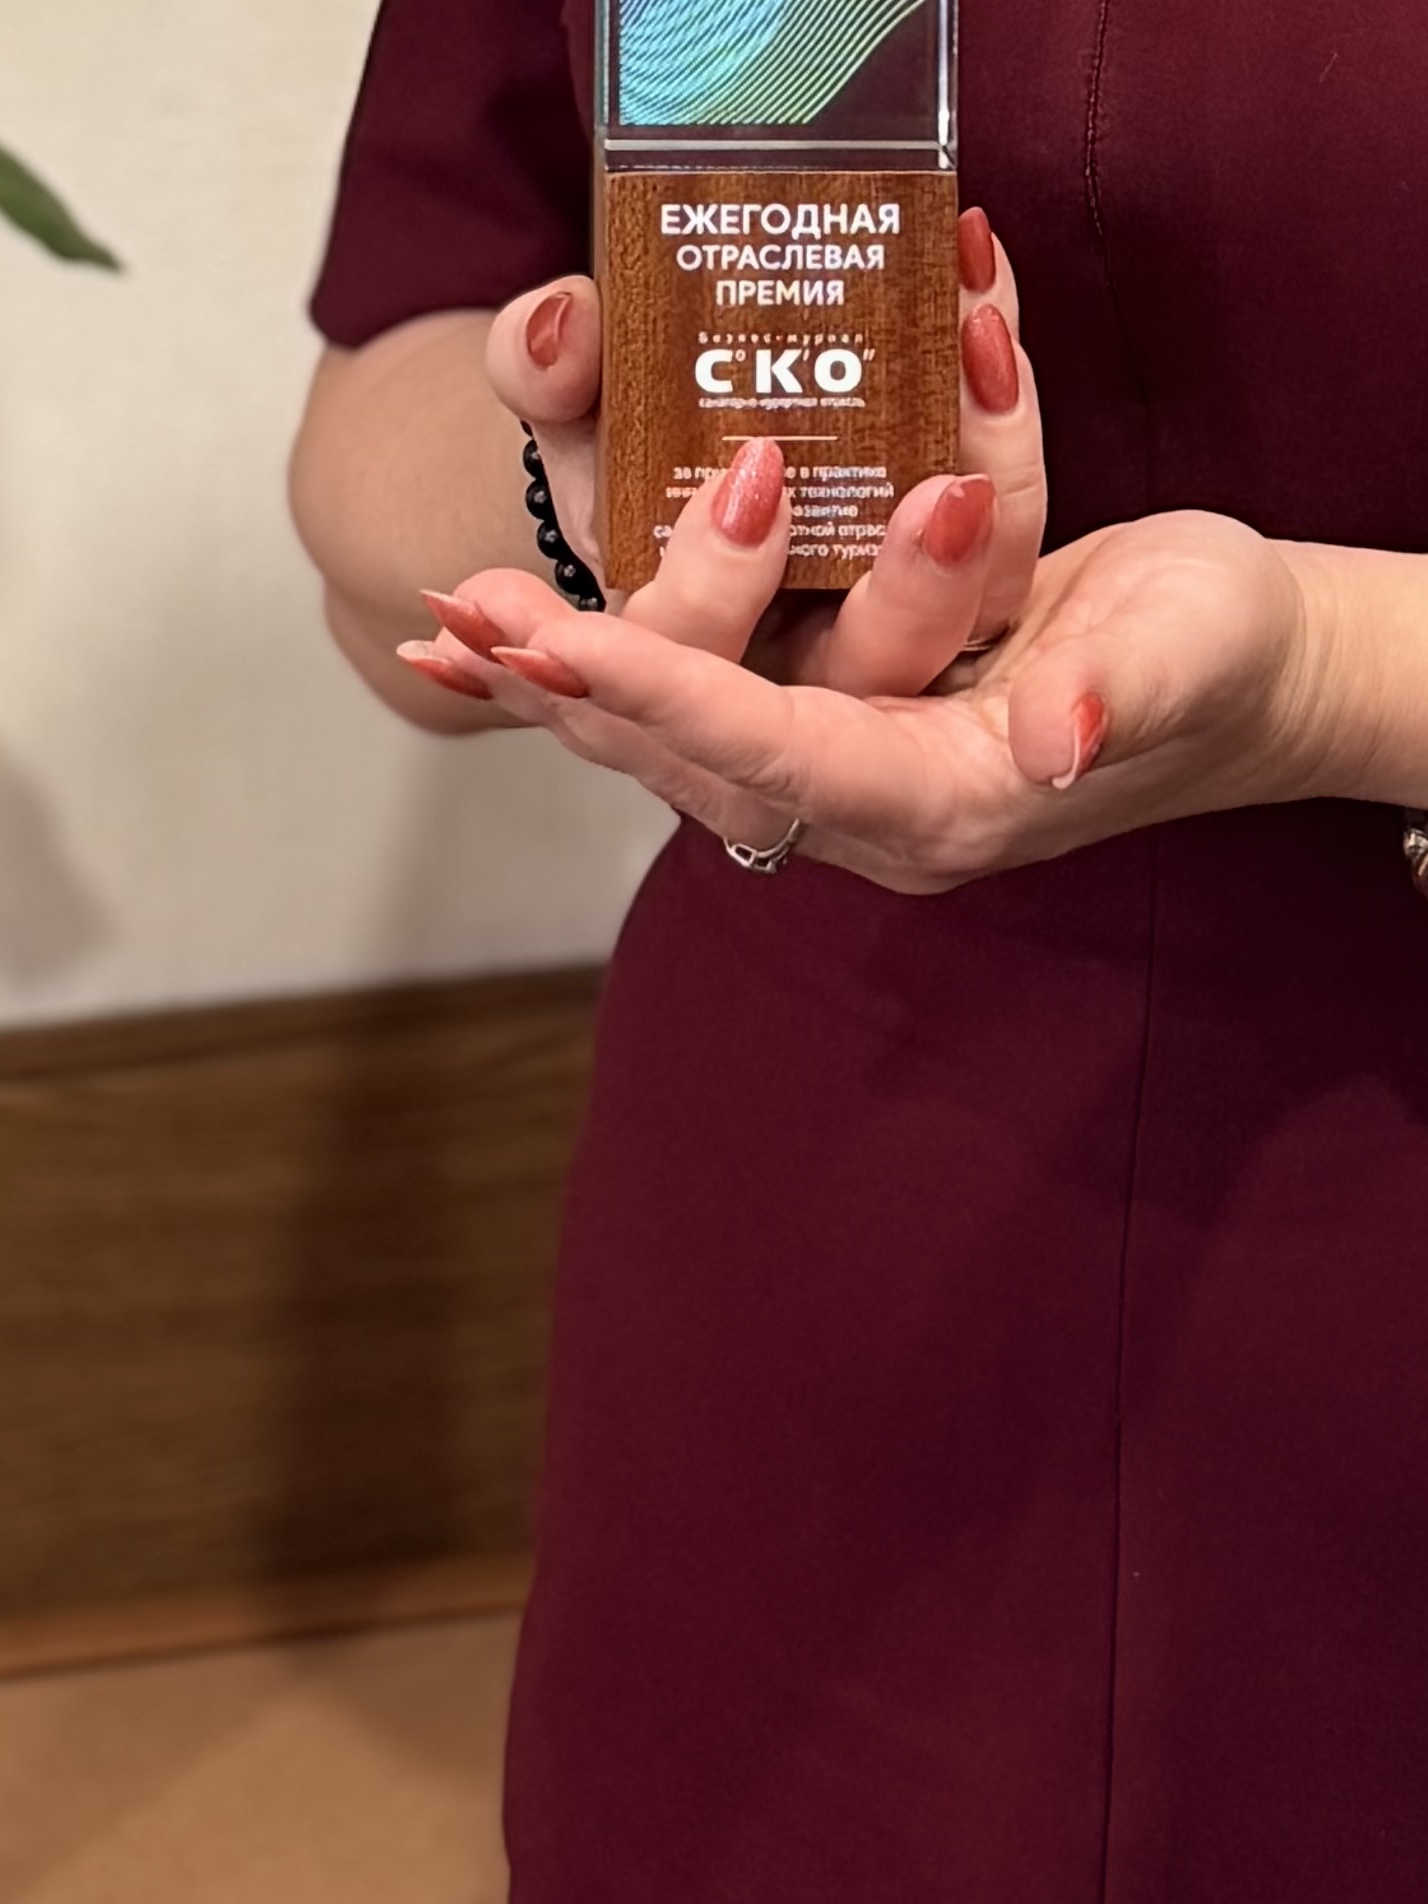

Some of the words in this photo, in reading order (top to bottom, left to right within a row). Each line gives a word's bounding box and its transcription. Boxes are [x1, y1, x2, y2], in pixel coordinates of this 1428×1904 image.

[660, 203, 901, 240] ЕЖЕГОДНАЯ
[676, 244, 885, 271] ОТРАСЛЕВАЯ
[716, 280, 845, 306] ПРЕМИЯ
